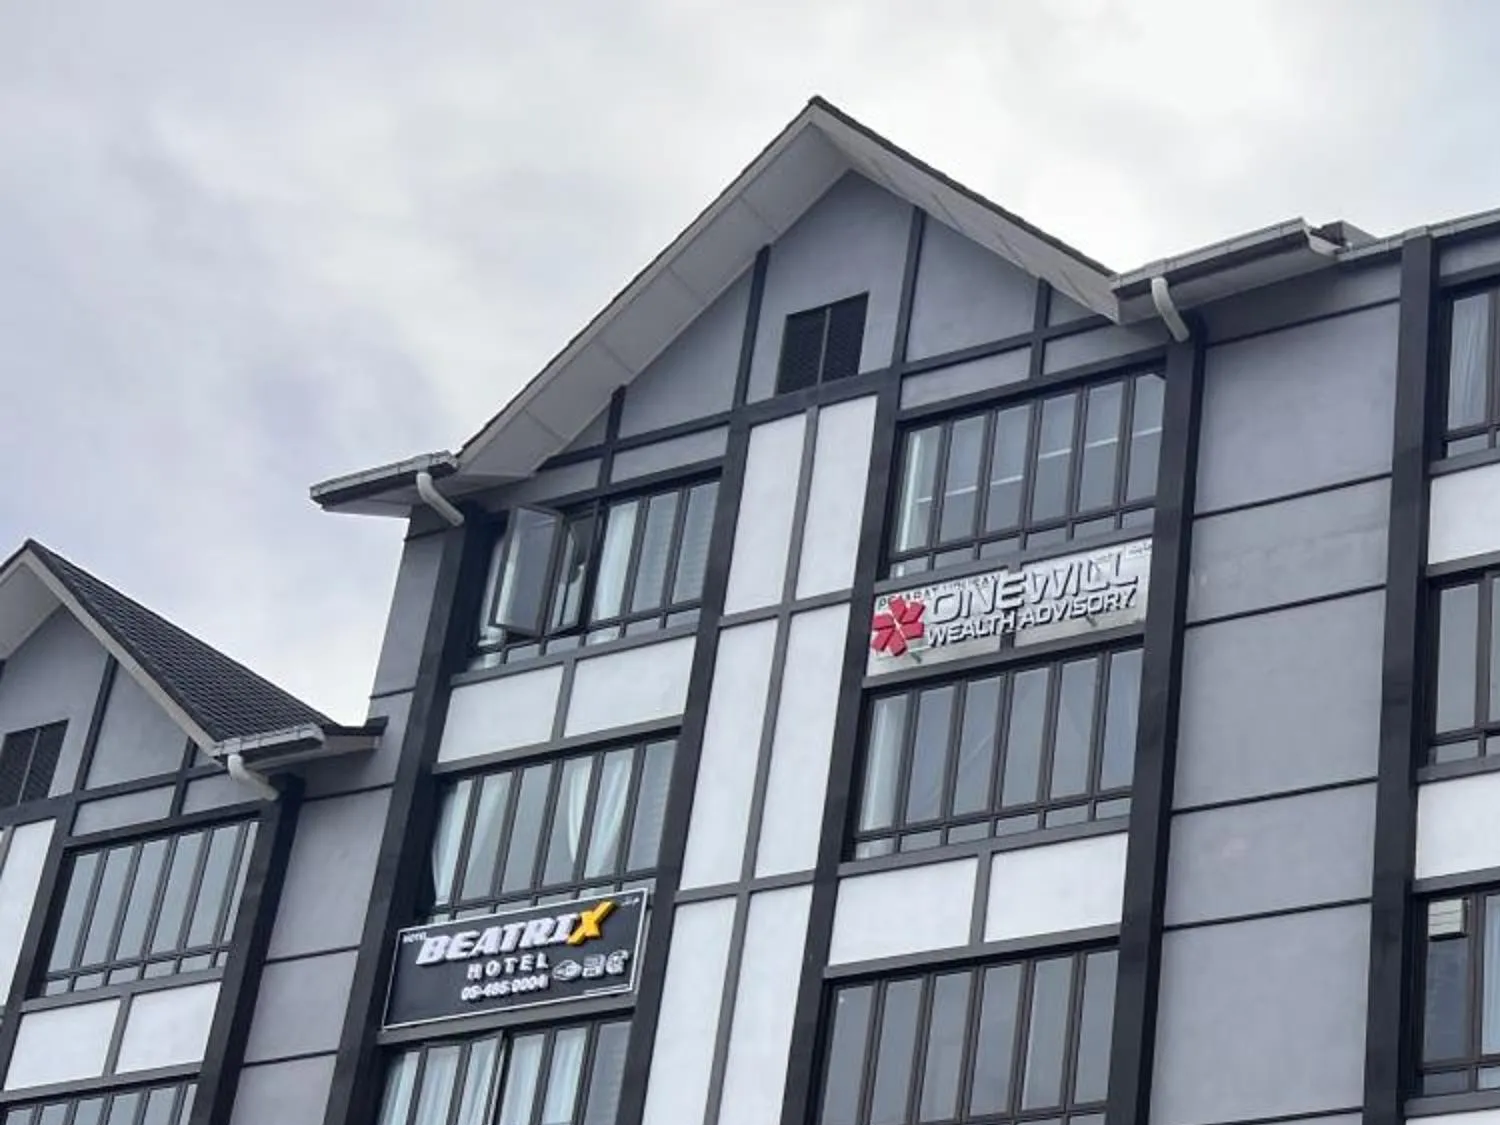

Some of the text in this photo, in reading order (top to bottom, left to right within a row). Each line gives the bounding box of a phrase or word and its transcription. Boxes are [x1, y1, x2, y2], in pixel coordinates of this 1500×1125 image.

[927, 586, 1138, 649] WEALTH ADVISORY
[930, 552, 1139, 624] ONEWILL
[416, 900, 614, 965] BEATRIX
[467, 952, 549, 980] HOTEL
